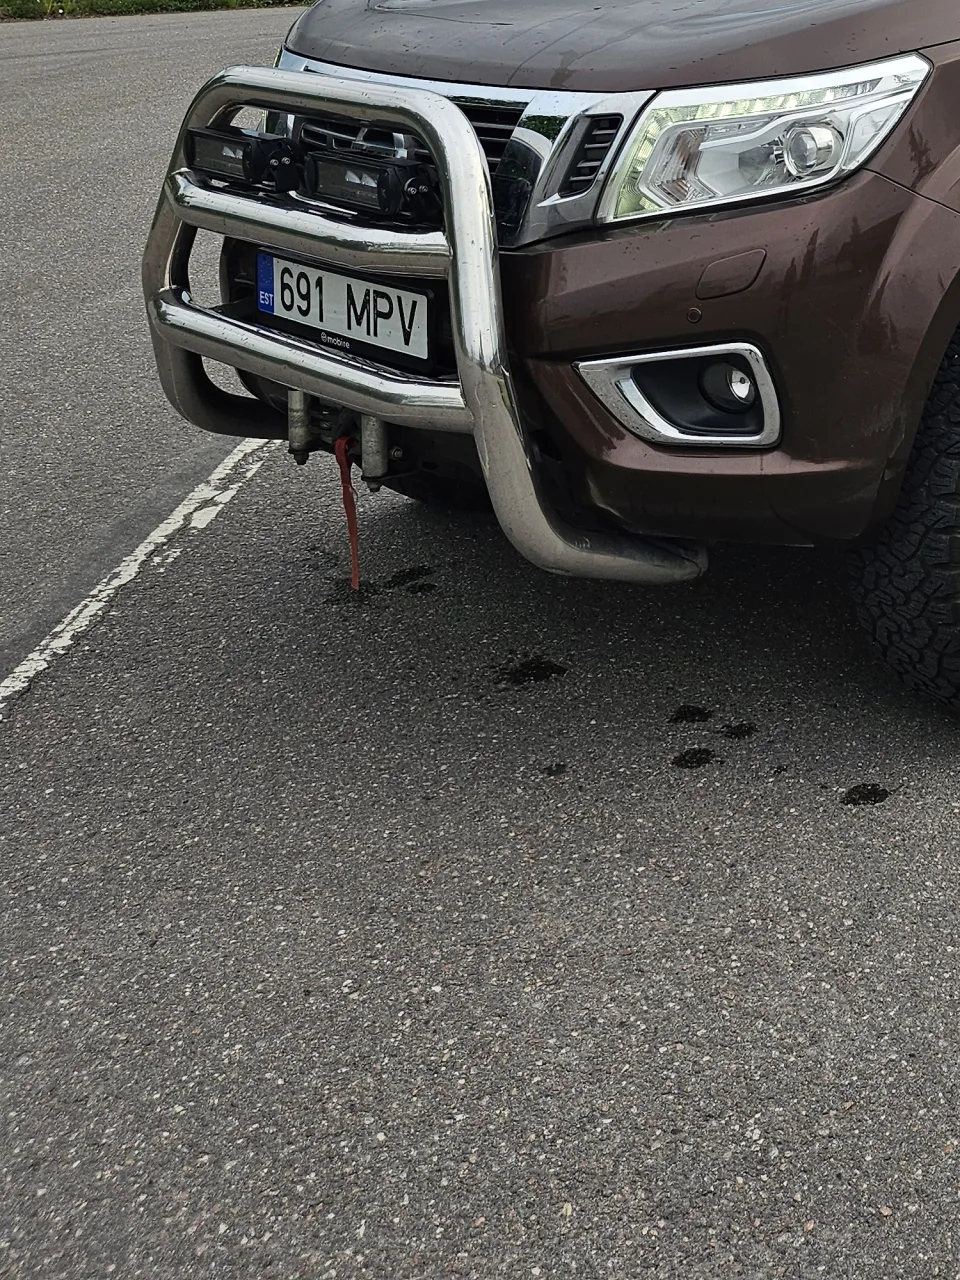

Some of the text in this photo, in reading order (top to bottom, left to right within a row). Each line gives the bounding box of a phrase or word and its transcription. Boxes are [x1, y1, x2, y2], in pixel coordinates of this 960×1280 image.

[259, 291, 274, 306] EST
[280, 266, 418, 347] 691 MPV
